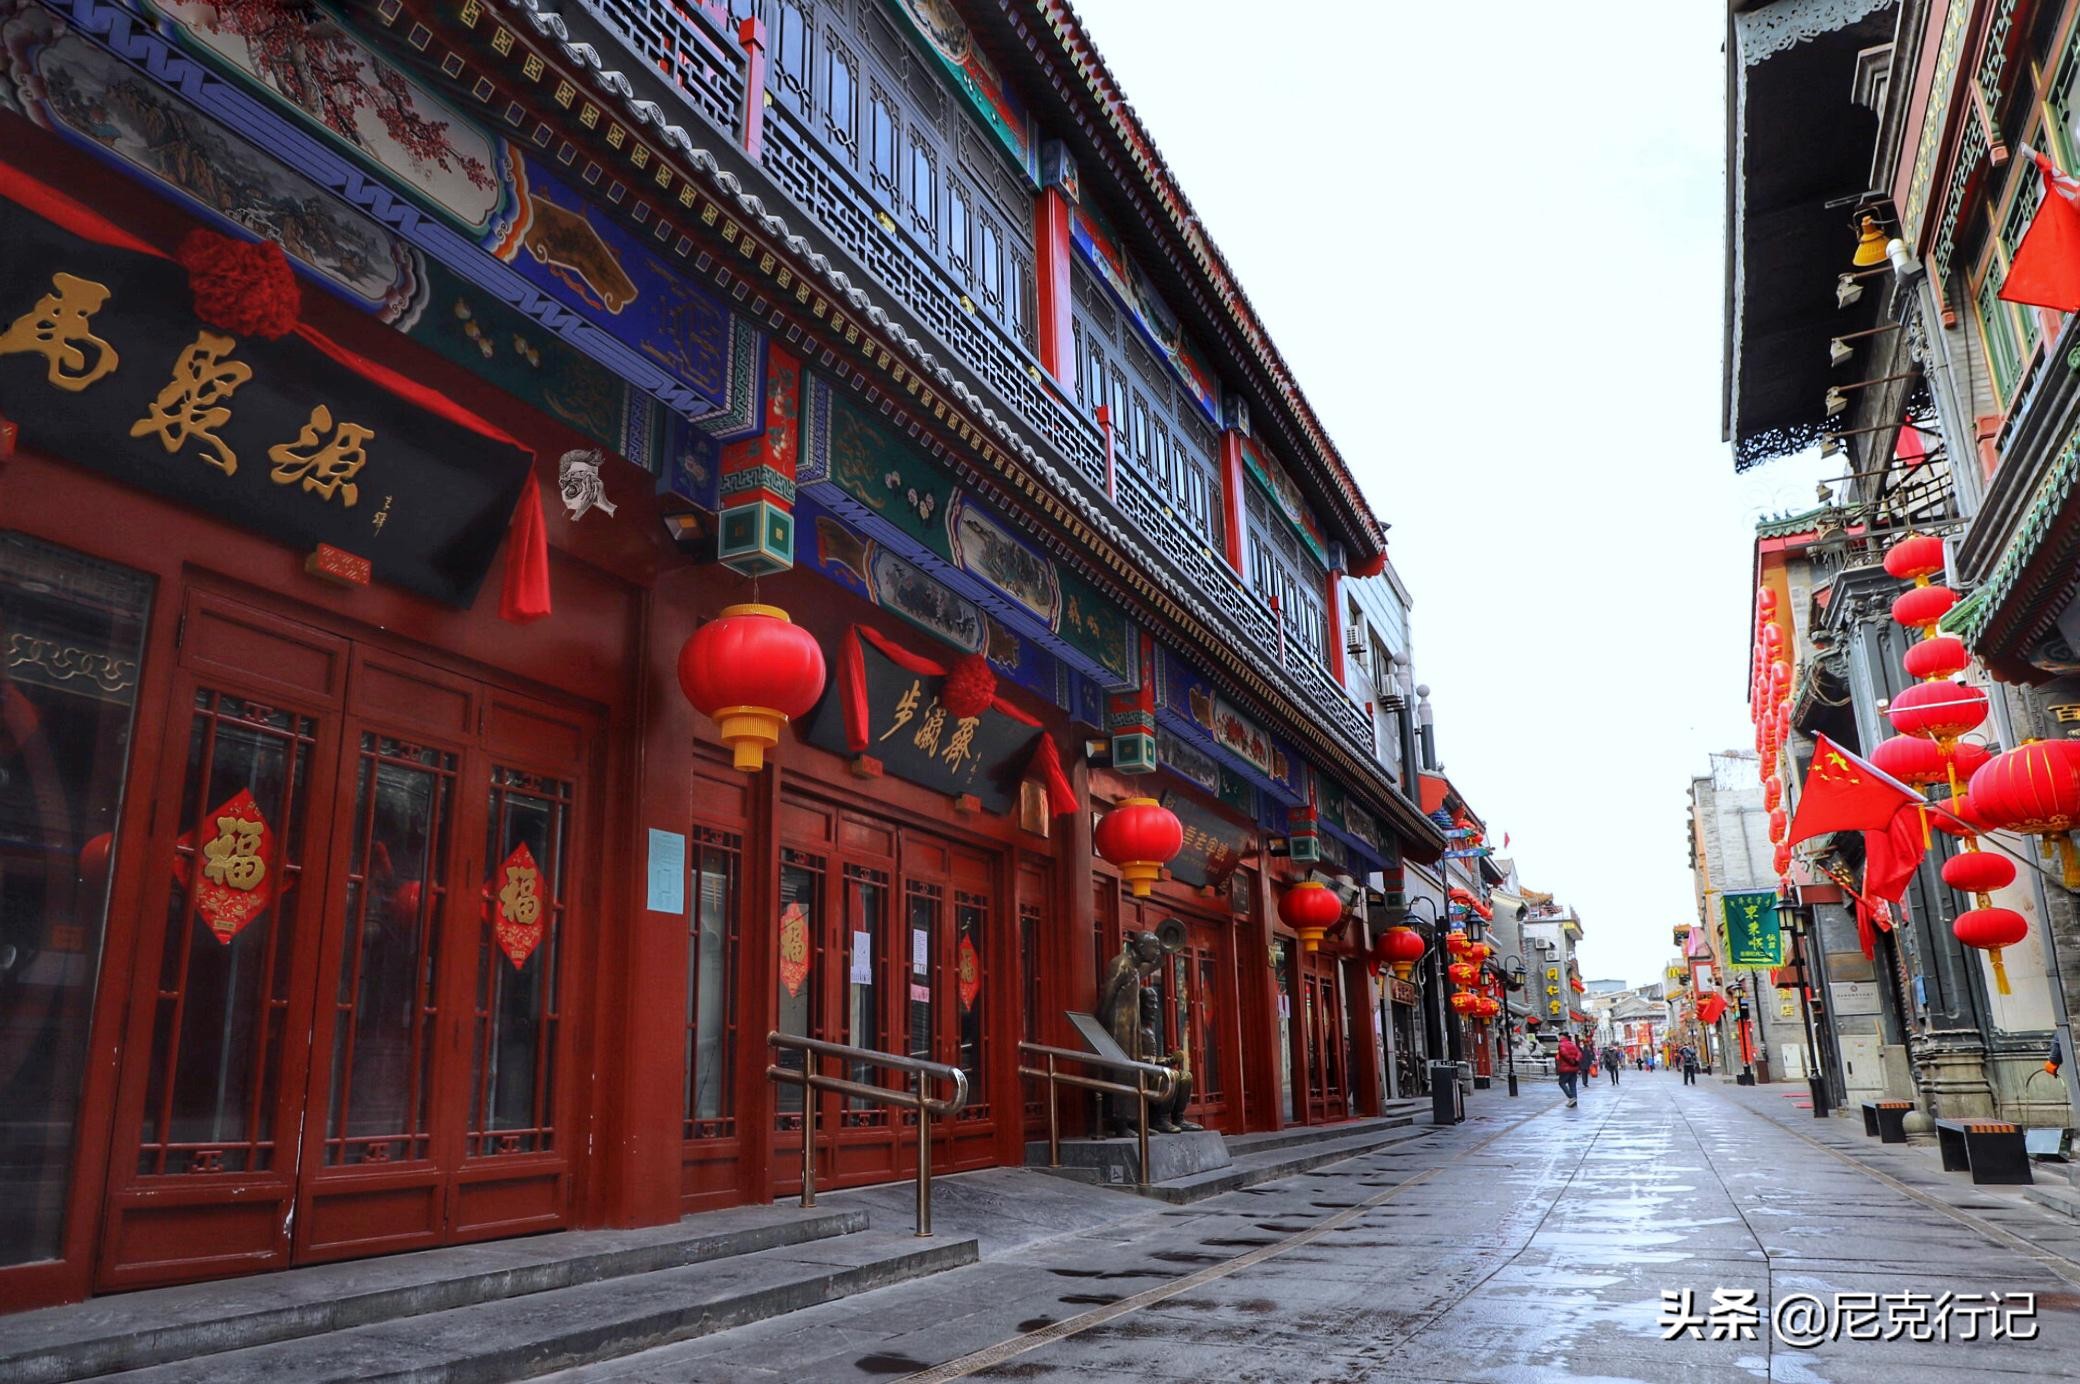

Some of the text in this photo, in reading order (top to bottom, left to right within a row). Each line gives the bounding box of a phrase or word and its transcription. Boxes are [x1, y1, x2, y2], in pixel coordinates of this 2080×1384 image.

[204, 816, 267, 891] 福
[500, 866, 541, 924] 福
[1546, 967, 1562, 1016] 同仁堂
